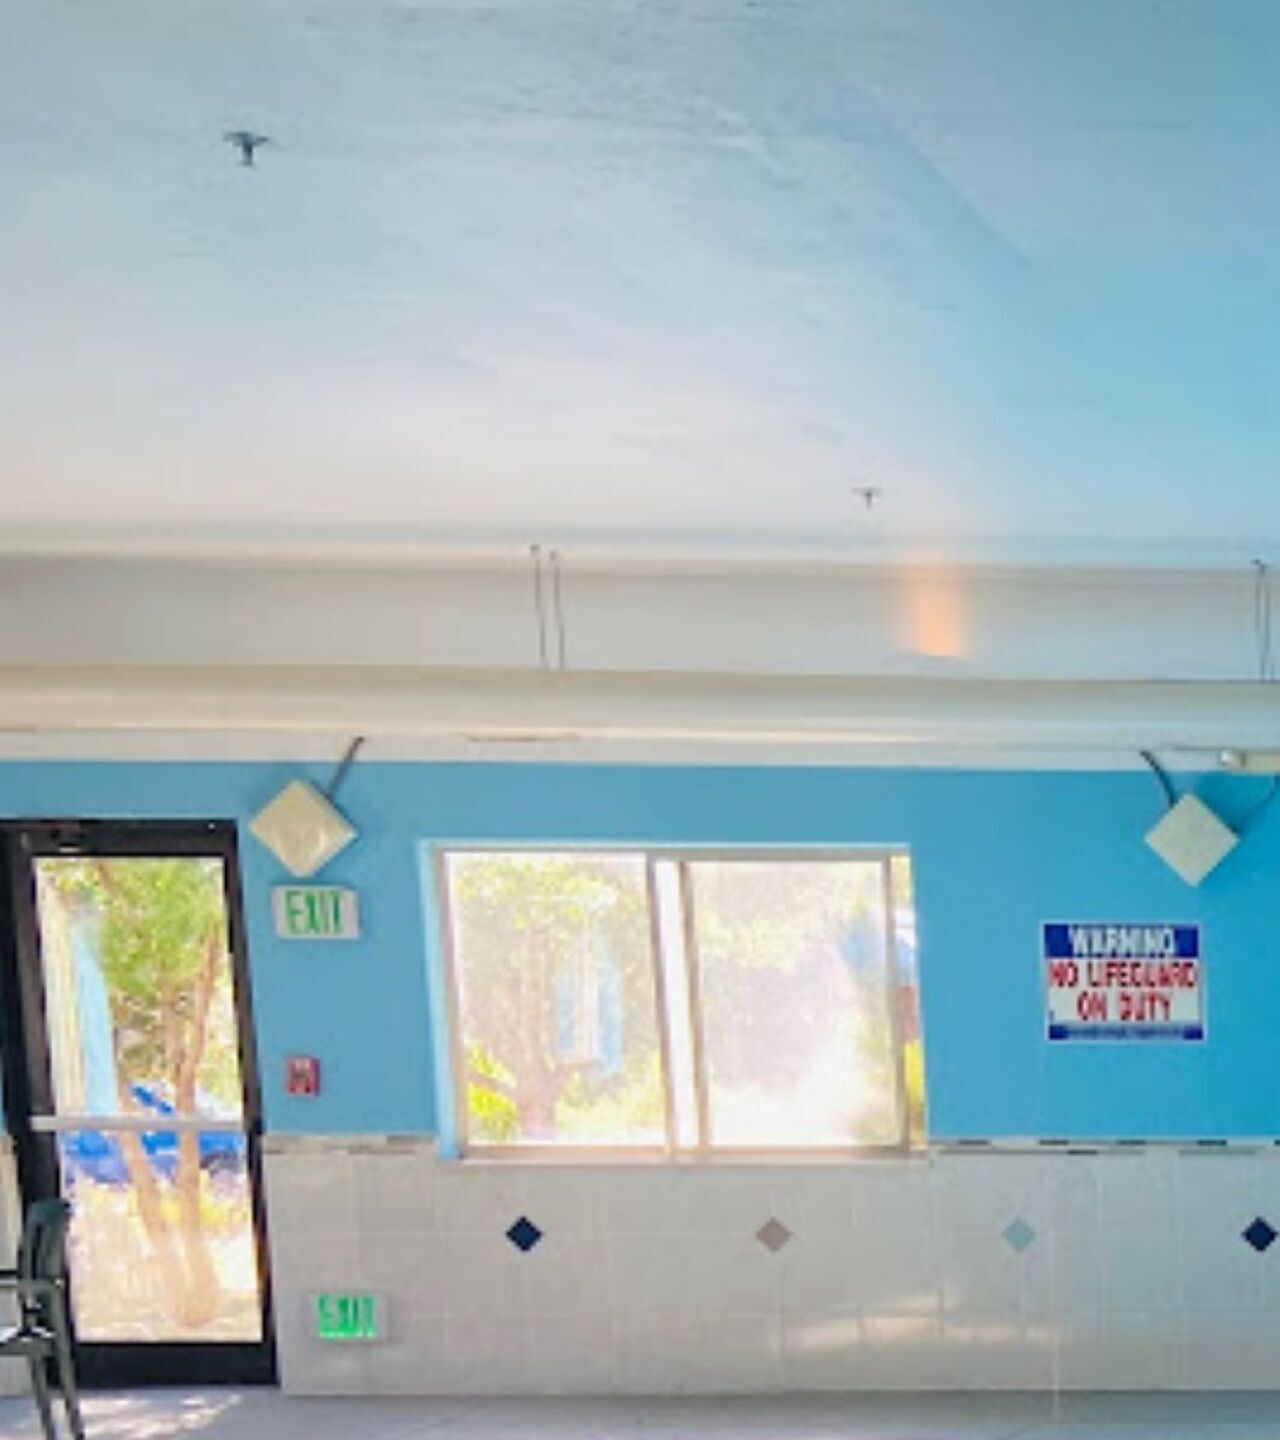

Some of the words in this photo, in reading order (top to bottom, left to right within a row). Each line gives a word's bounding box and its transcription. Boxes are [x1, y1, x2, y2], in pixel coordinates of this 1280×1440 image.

[285, 889, 342, 935] EXIT
[1068, 926, 1174, 957] WARNING
[1049, 961, 1079, 988] NO
[1087, 961, 1196, 988] LIFEGUARD
[1077, 991, 1107, 1021] ON
[1119, 991, 1171, 1021] DUTY
[318, 1294, 375, 1338] EXIT
